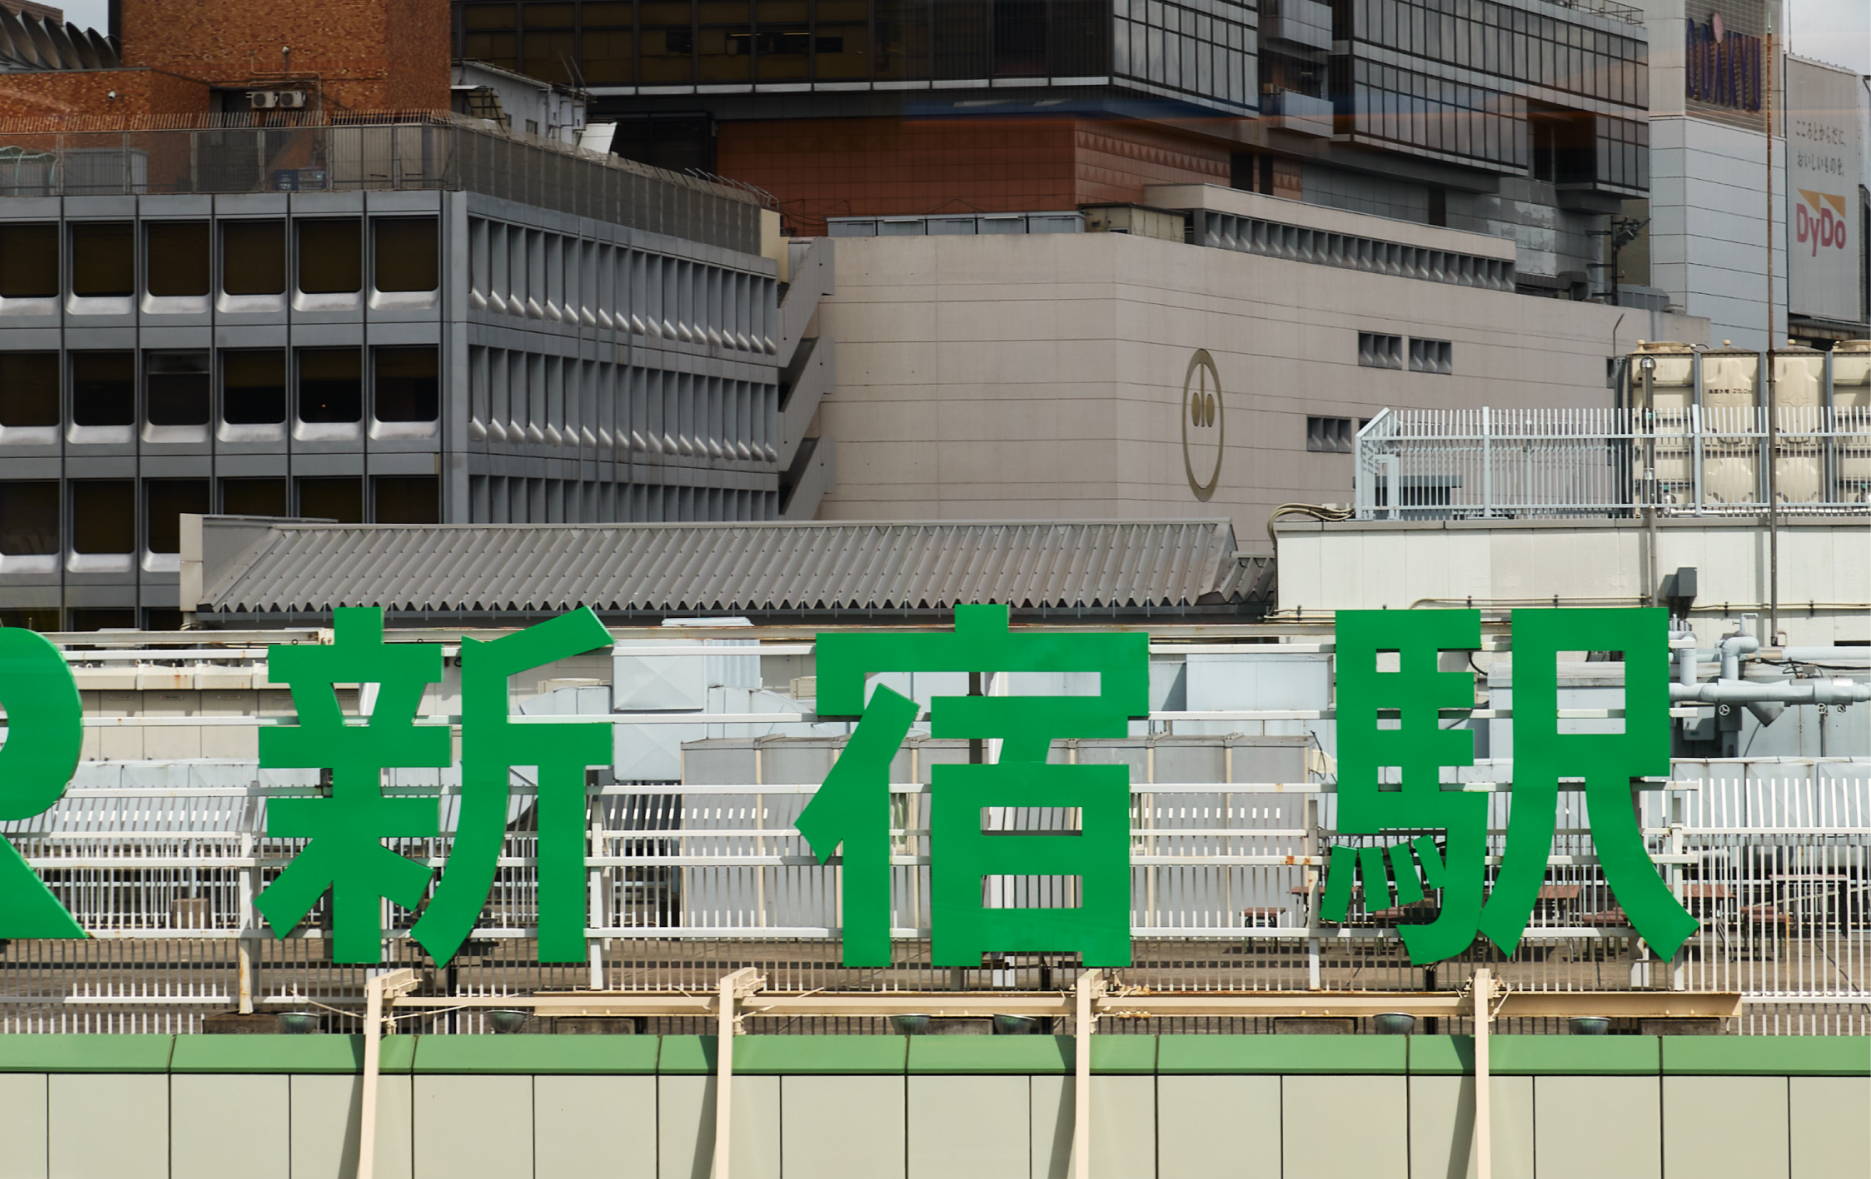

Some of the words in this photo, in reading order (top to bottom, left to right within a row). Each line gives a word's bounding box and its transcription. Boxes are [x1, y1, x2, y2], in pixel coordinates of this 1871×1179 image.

[1796, 202, 1847, 258] DyDo
[254, 604, 1699, 969] 新宿駅
